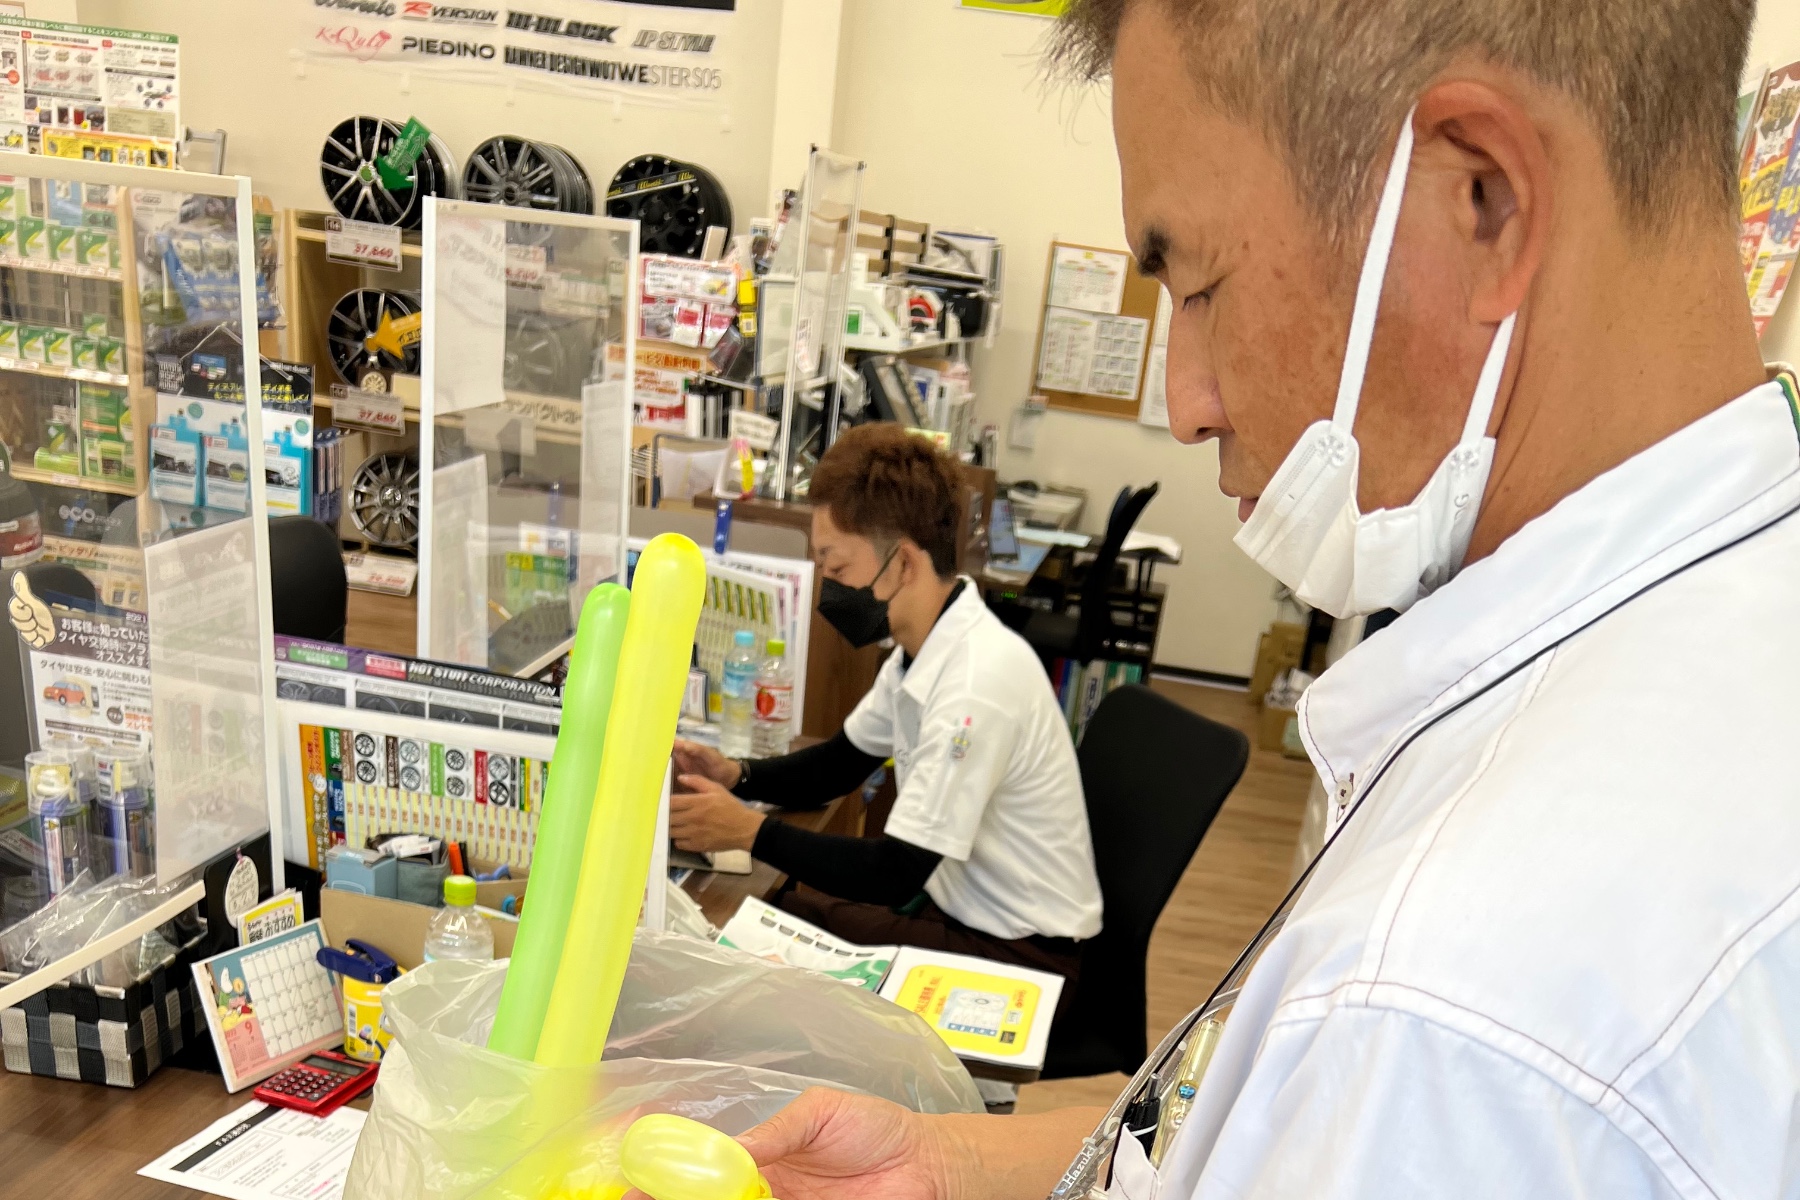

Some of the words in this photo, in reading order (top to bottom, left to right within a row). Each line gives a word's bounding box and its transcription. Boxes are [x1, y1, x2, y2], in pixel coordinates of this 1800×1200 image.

[402, 36, 496, 59] PIEDINO
[408, 661, 433, 675] HOT
[434, 665, 469, 683] STUFF
[468, 673, 557, 697] CORPORATION
